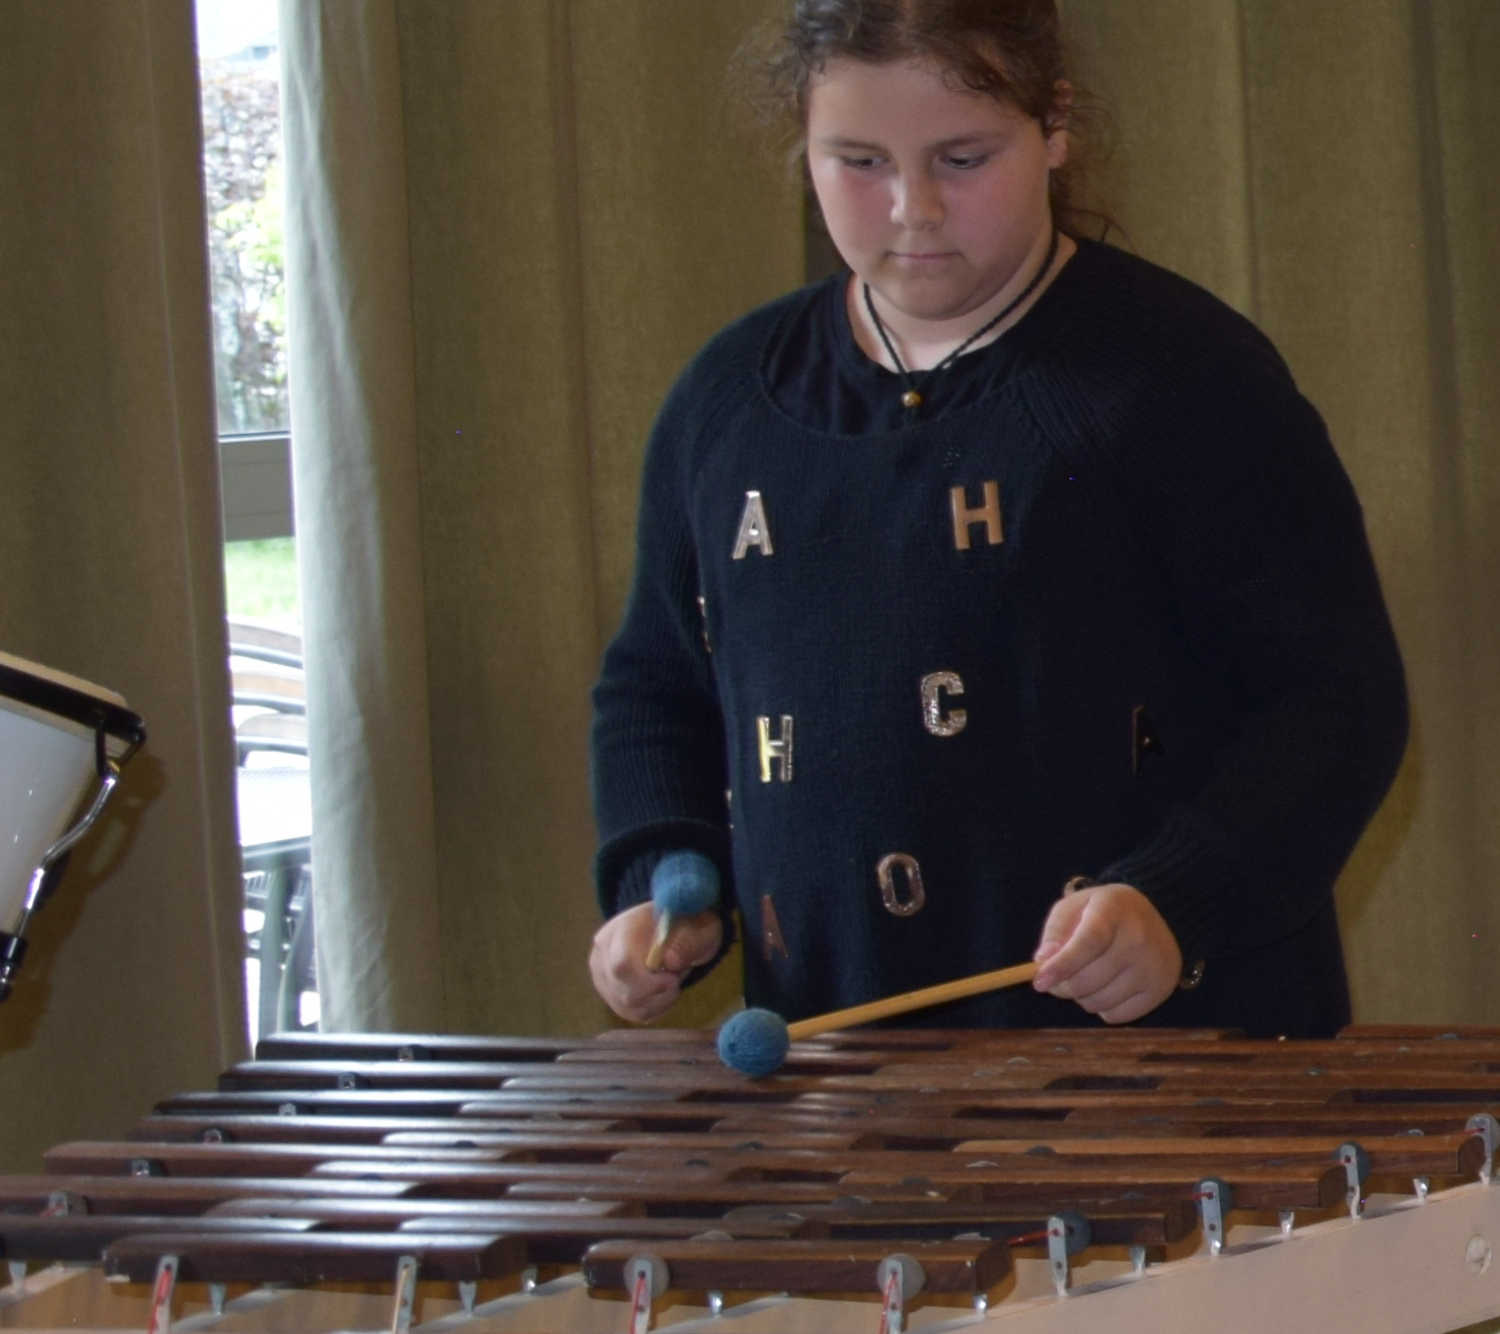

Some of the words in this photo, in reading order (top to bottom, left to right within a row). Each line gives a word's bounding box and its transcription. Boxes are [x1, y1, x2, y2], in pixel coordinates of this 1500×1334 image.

[732, 489, 775, 560] A
[949, 480, 1004, 551] H
[919, 670, 968, 737] C
[756, 714, 795, 784] H
